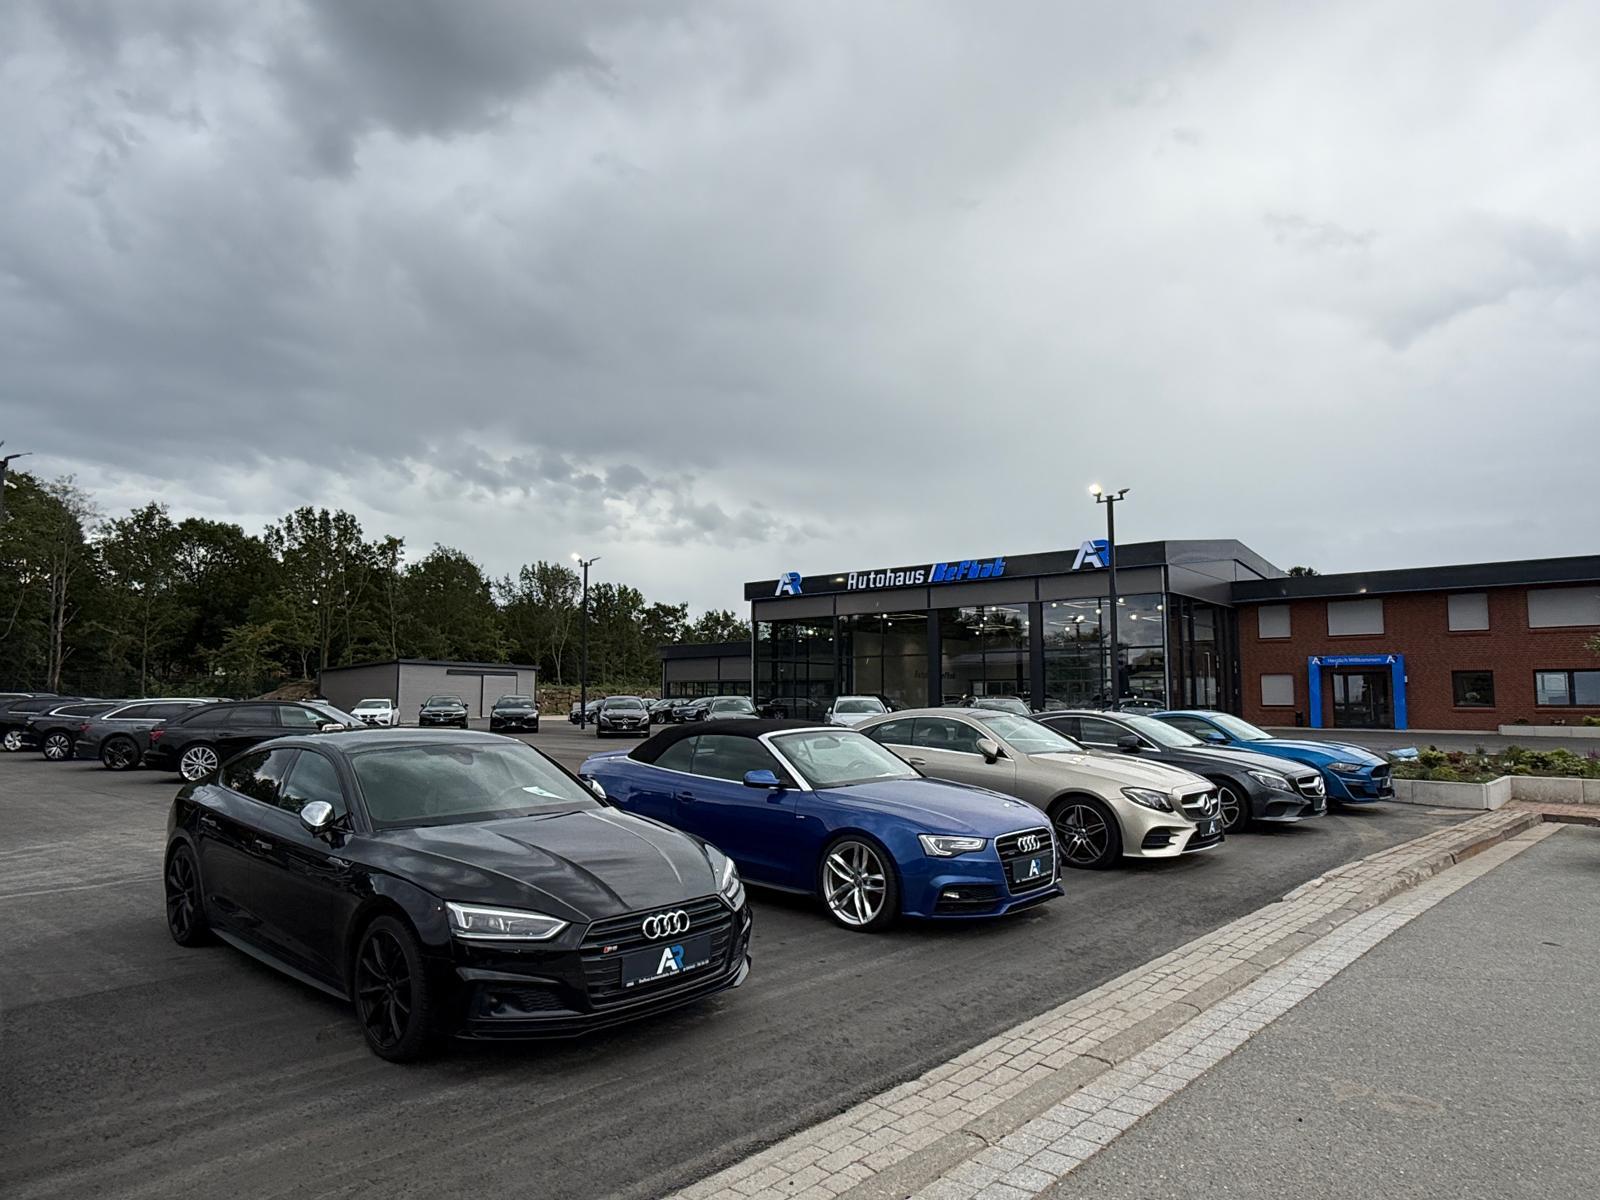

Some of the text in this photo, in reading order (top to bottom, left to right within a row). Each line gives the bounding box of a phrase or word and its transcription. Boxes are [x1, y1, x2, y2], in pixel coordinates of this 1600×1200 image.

[775, 571, 803, 596] AR
[847, 568, 925, 590] Autohaus
[657, 943, 685, 975] AR
